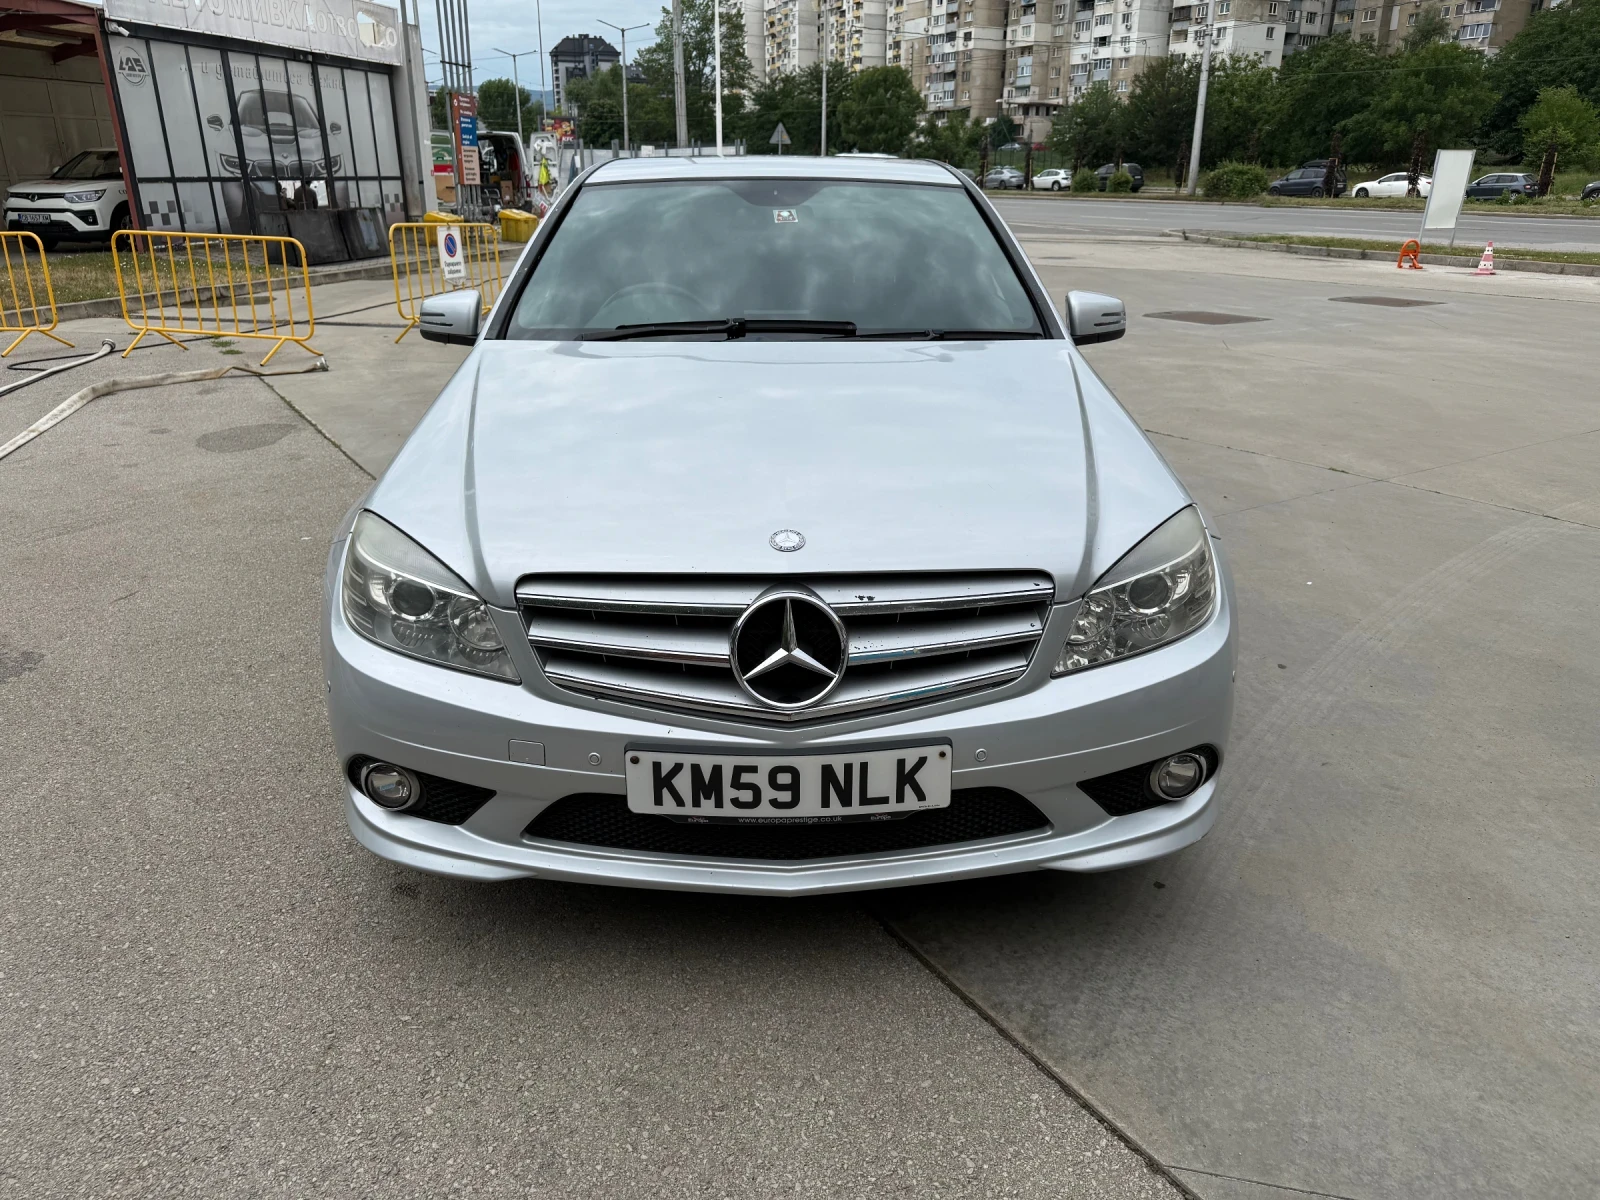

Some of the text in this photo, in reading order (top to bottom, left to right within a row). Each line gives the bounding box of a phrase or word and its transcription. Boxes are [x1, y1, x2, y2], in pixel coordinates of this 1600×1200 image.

[149, 0, 318, 33] ОМИВКА
[652, 756, 928, 809] KM59 NLK
[738, 815, 843, 824] www.europaprestige.co.uk
